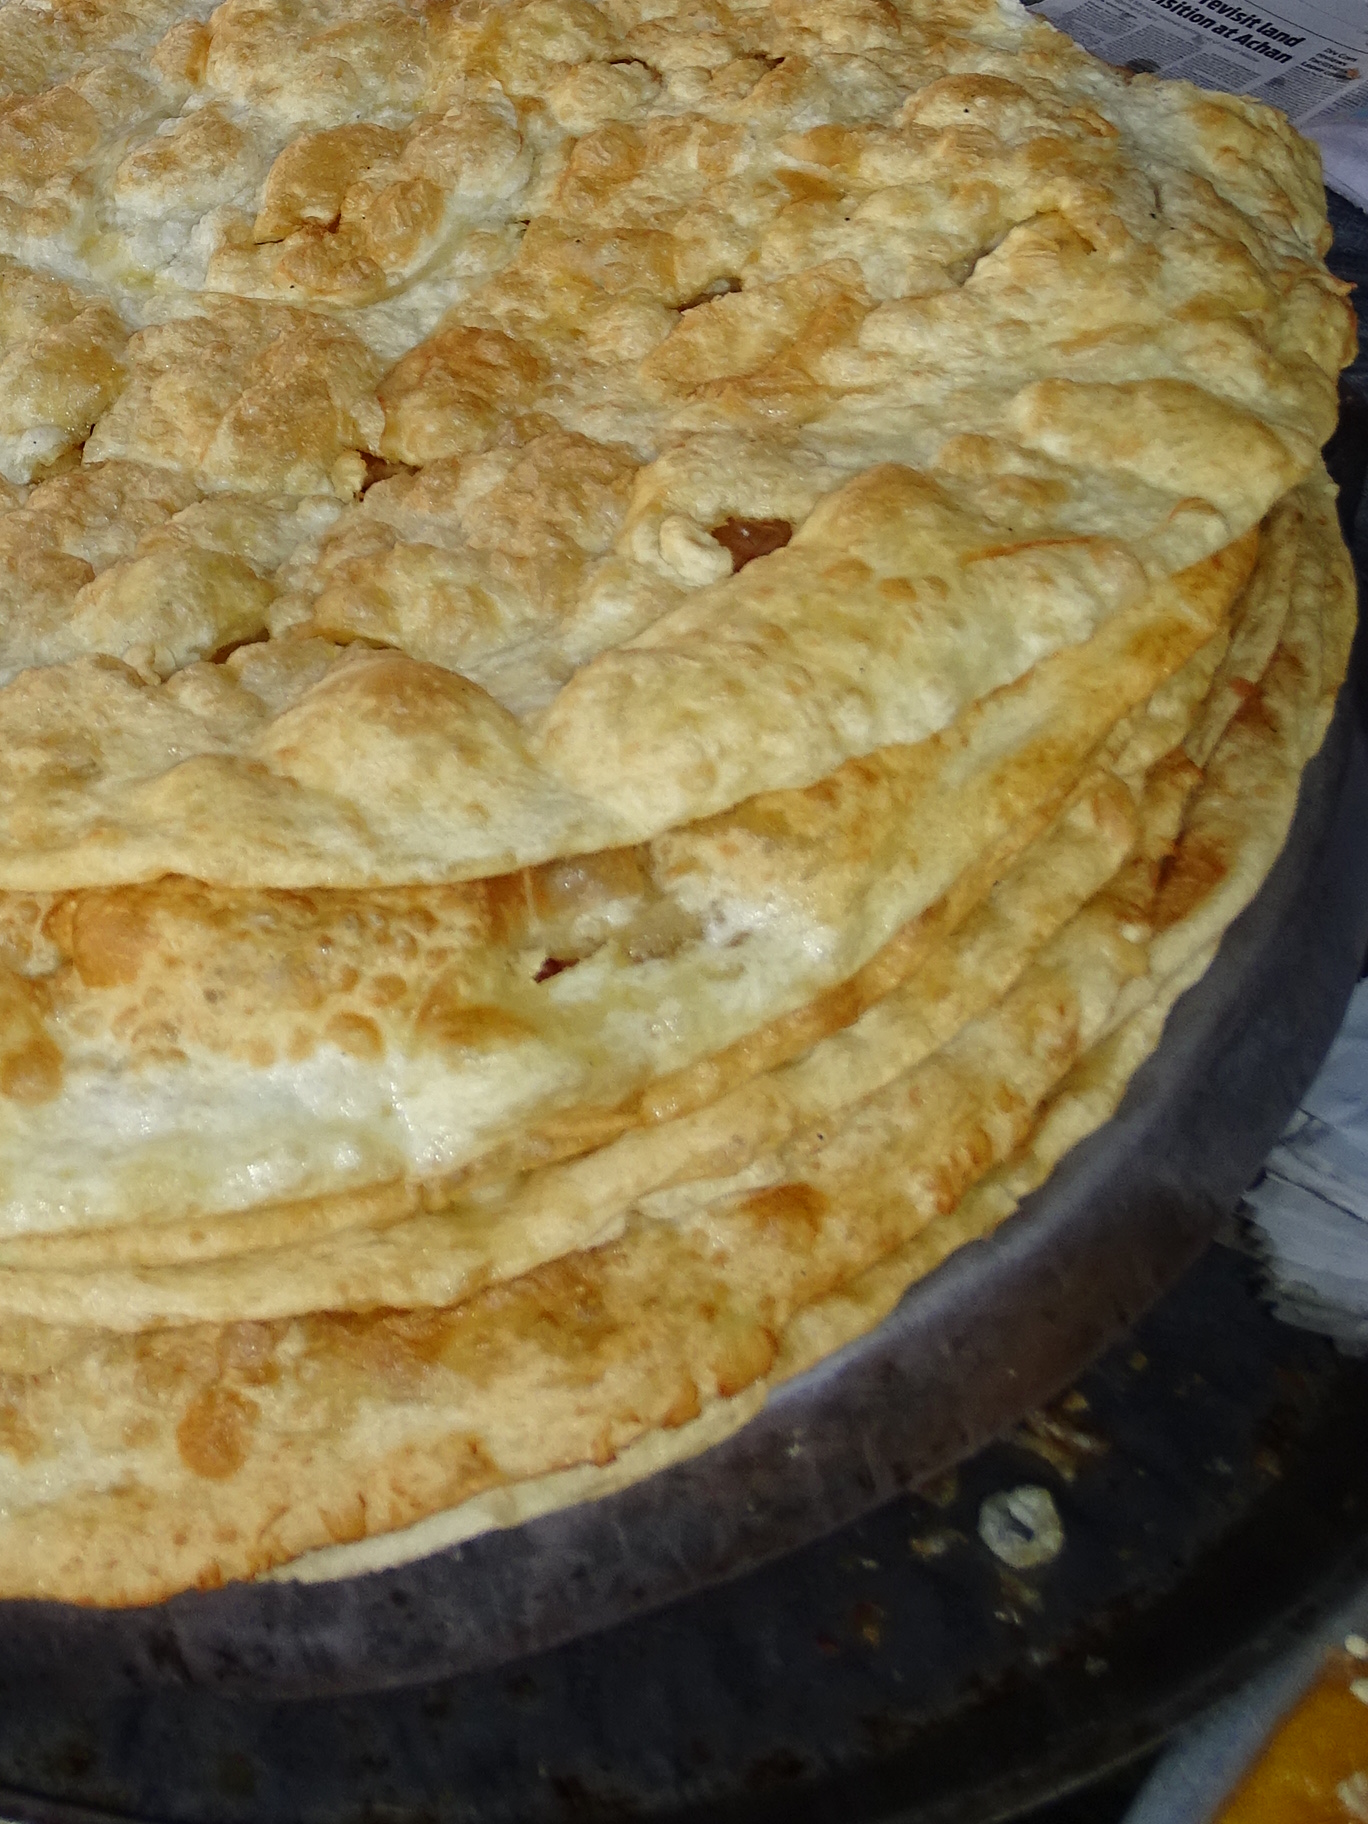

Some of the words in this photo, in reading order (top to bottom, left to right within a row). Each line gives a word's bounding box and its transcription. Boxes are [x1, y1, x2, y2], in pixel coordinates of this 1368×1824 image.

[1213, 21, 1238, 43] at
[1232, 30, 1295, 65] Achan
[1256, 20, 1306, 48] land
